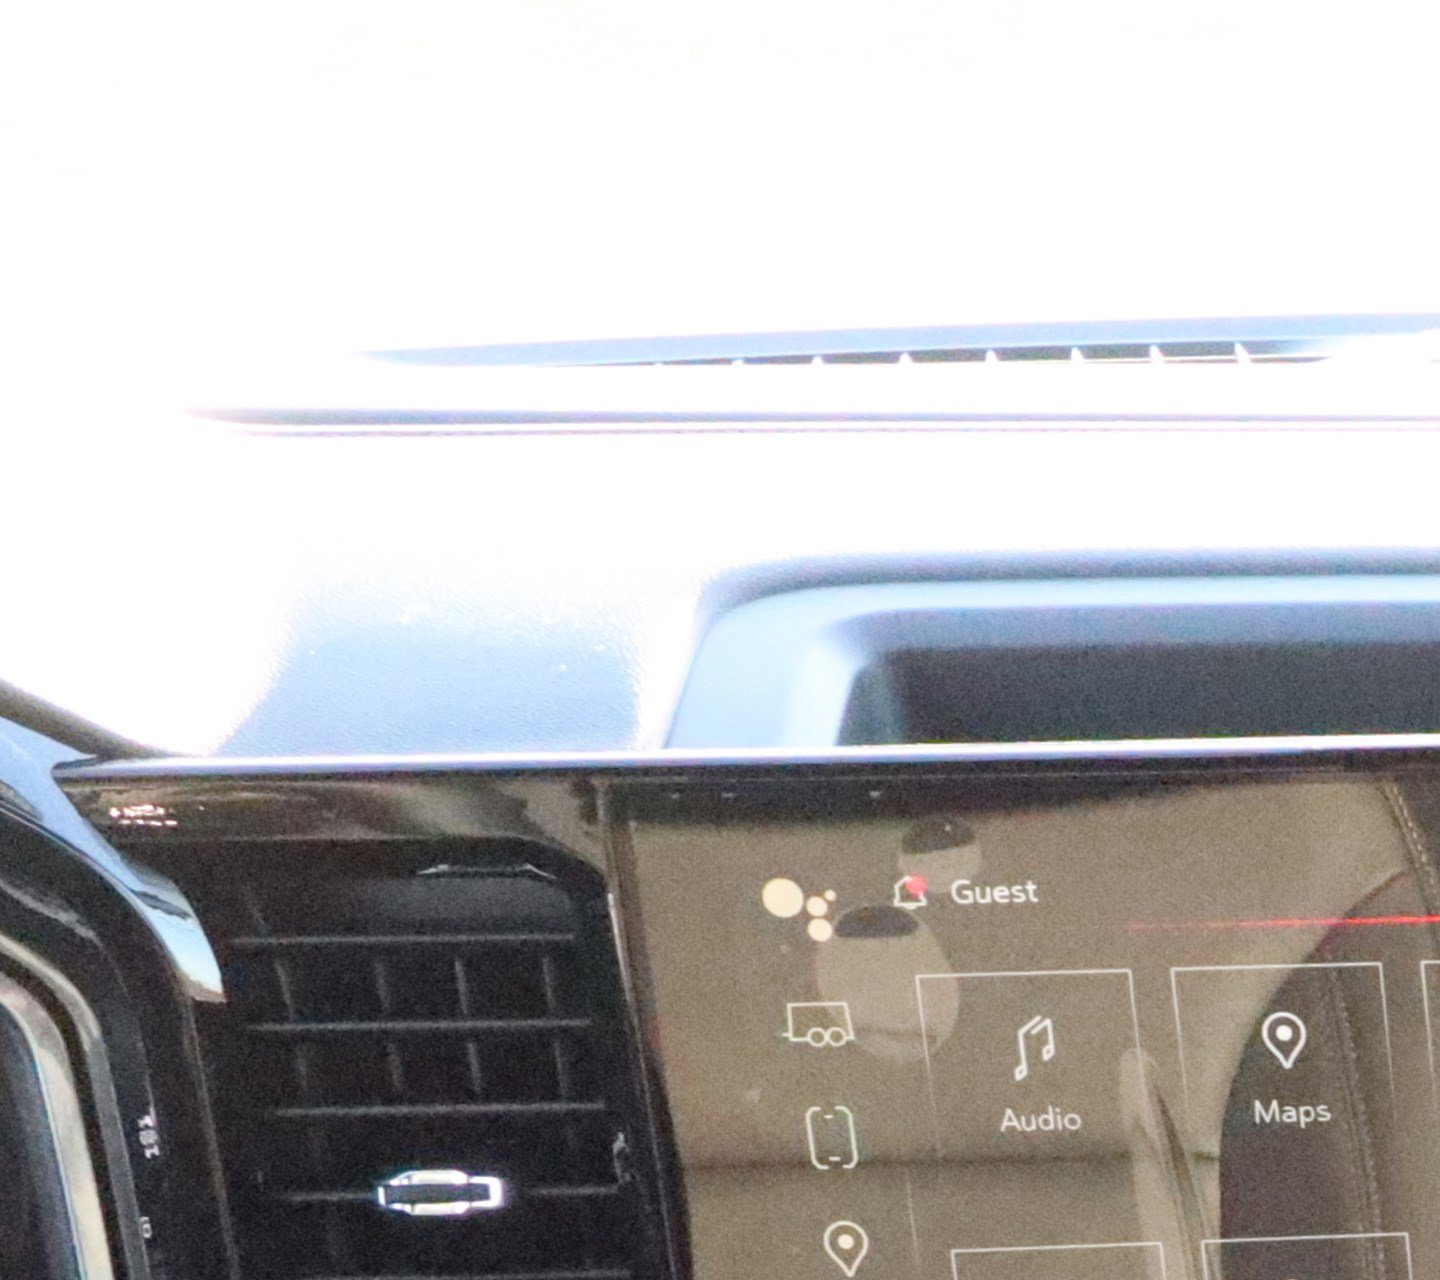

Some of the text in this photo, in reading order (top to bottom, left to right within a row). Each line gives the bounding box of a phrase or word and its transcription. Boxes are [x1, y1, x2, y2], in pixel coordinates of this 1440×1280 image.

[950, 878, 1039, 905] Guest
[999, 1106, 1082, 1133] Audio
[1253, 1099, 1332, 1130] Maps
